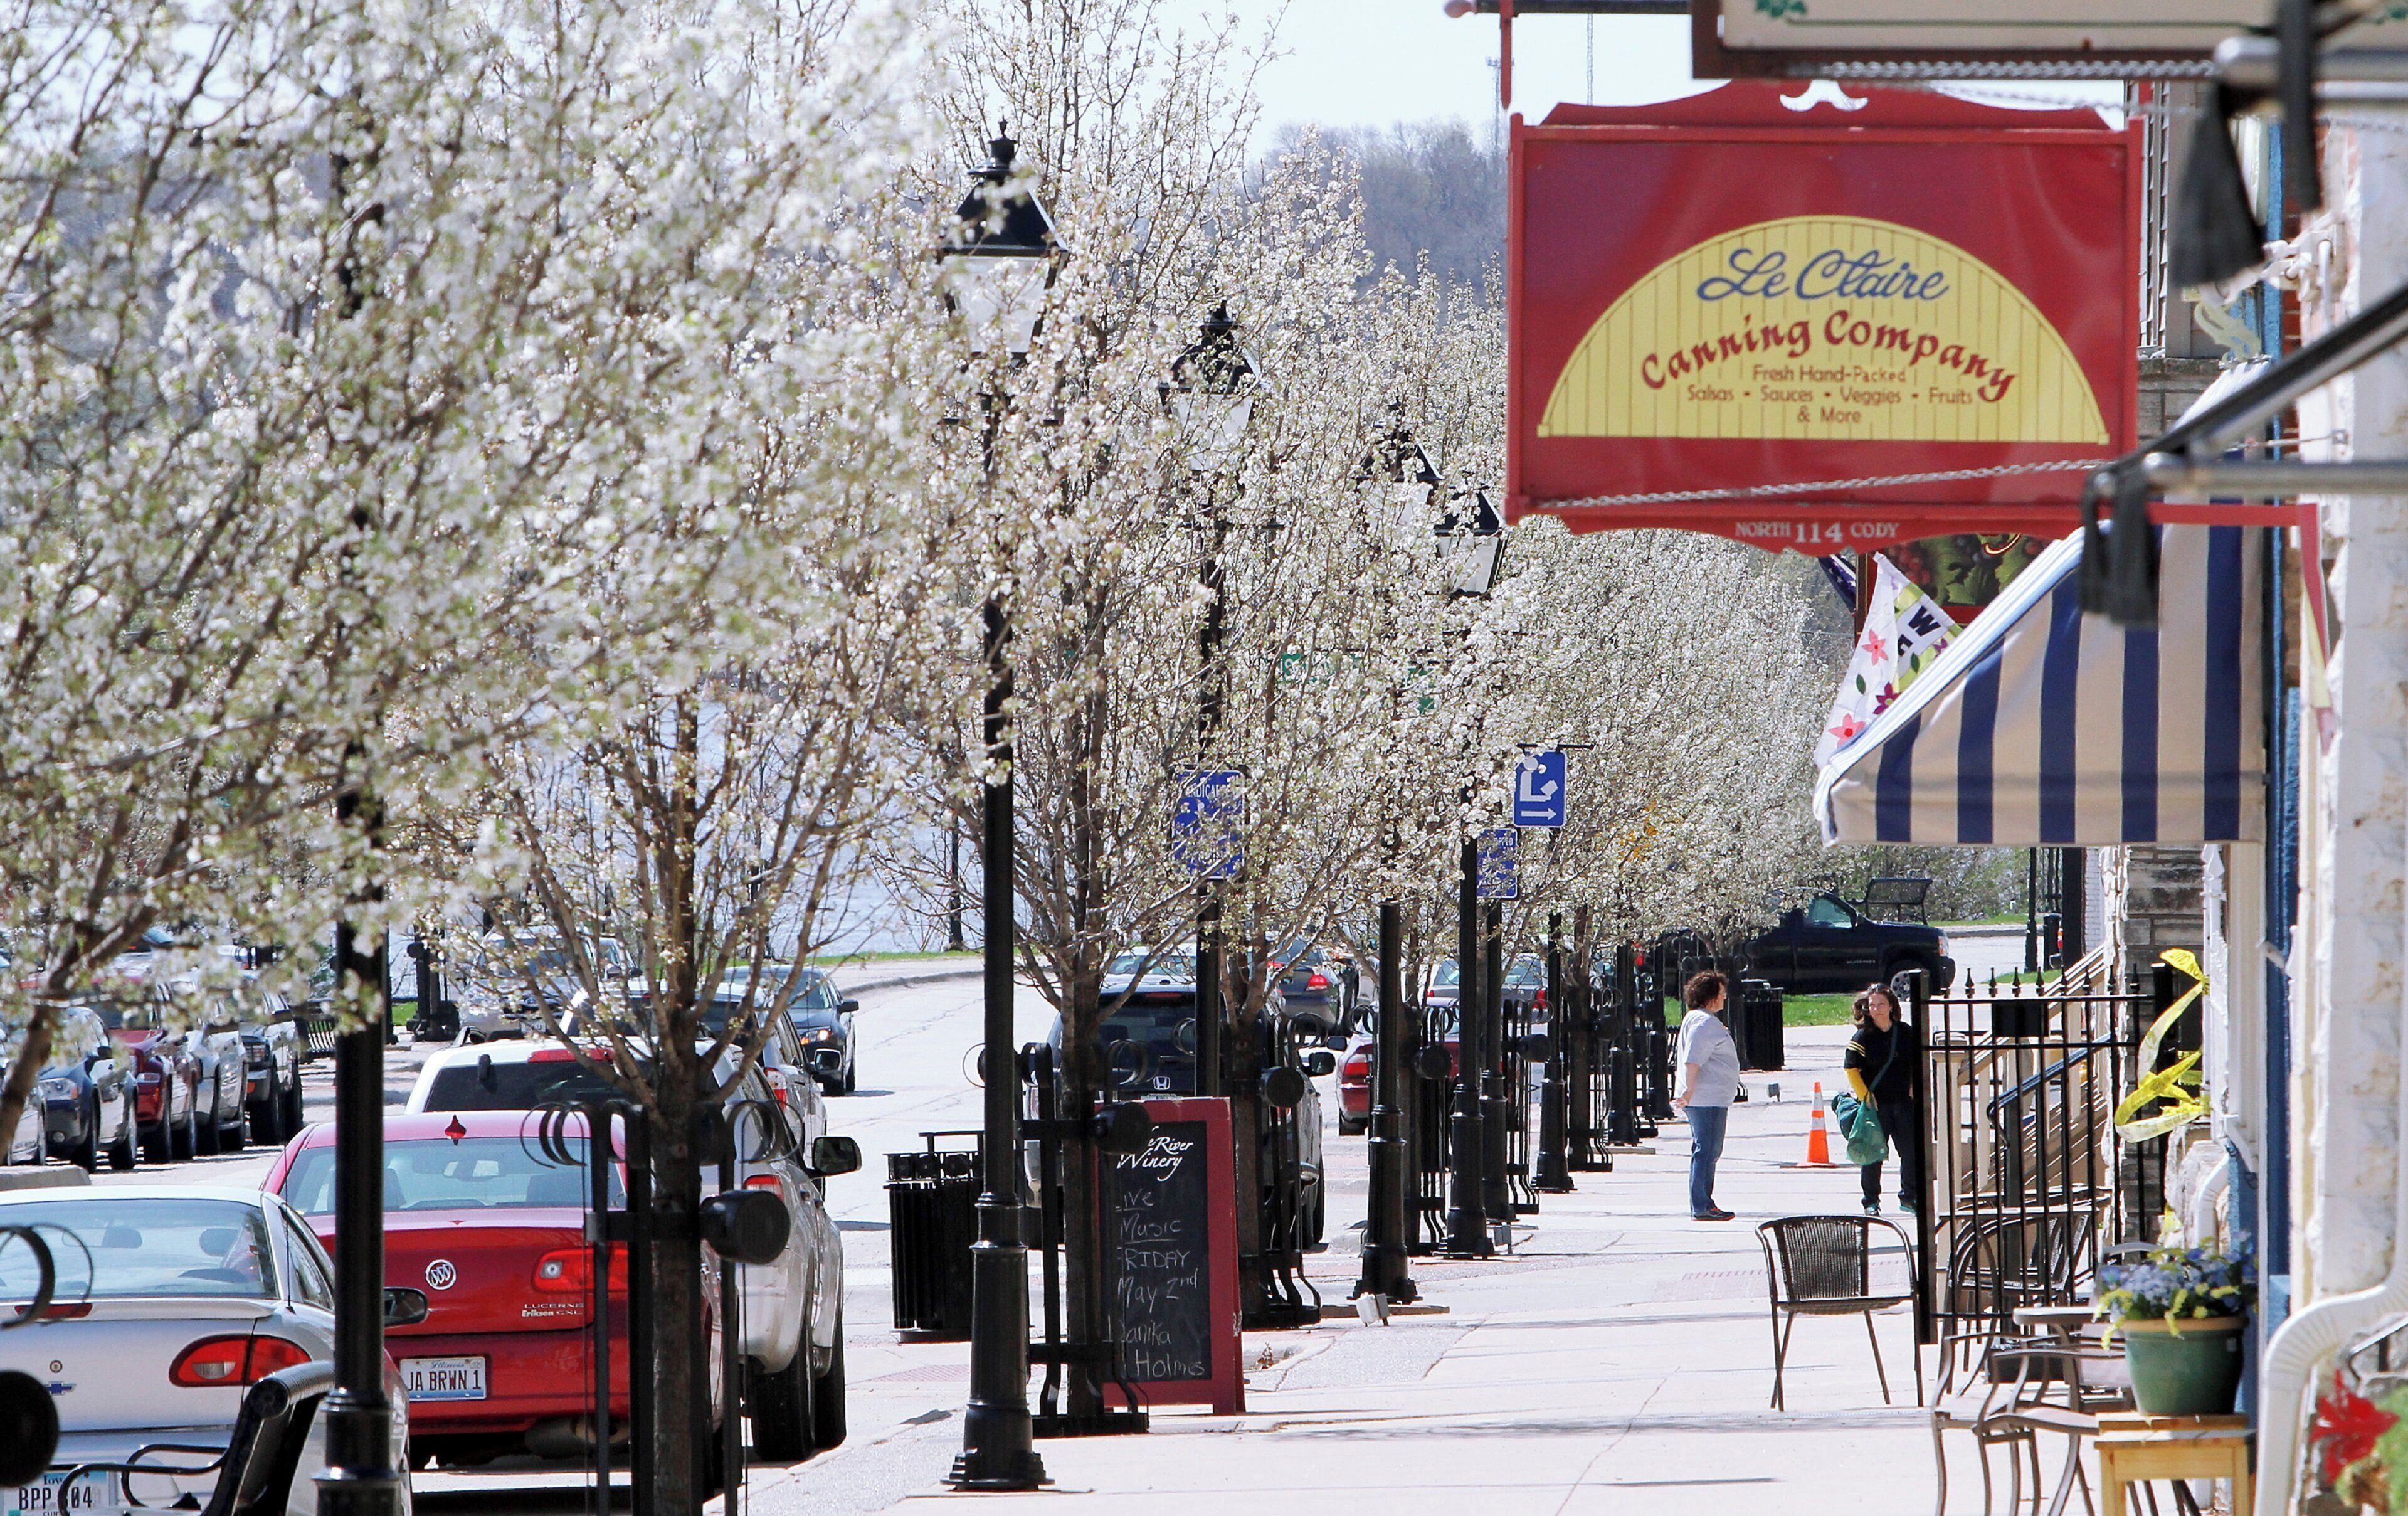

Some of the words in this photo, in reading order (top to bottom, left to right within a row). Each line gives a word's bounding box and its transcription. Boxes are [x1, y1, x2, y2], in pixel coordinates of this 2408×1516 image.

[1697, 248, 1790, 301] Le
[1795, 249, 1950, 301] Claire
[1642, 313, 1811, 390] Canning
[1824, 310, 2015, 403] Company
[1753, 364, 1794, 382] Fresh
[1799, 365, 1906, 383] Hand-Packed
[1687, 384, 1734, 402] Salsas
[1761, 386, 1814, 403] Sauces
[1840, 387, 1901, 405] Veggies
[1929, 388, 1973, 405] Fruits
[1797, 406, 1810, 423] &
[1820, 406, 1861, 423] More
[1735, 521, 1792, 538] NORTH
[1795, 522, 1844, 543] 114
[1851, 522, 1899, 538] CODY
[1154, 1137, 1193, 1155] River
[1116, 1148, 1183, 1182] Winery
[1116, 1188, 1154, 1208] ive
[1117, 1247, 1190, 1270] RIDAY
[1118, 1276, 1158, 1313] May
[1166, 1268, 1198, 1300] 2nd
[430, 1370, 467, 1391] BRWN
[472, 1369, 482, 1390] 1
[43, 1475, 63, 1485] Iow
[19, 1487, 51, 1510] BPP
